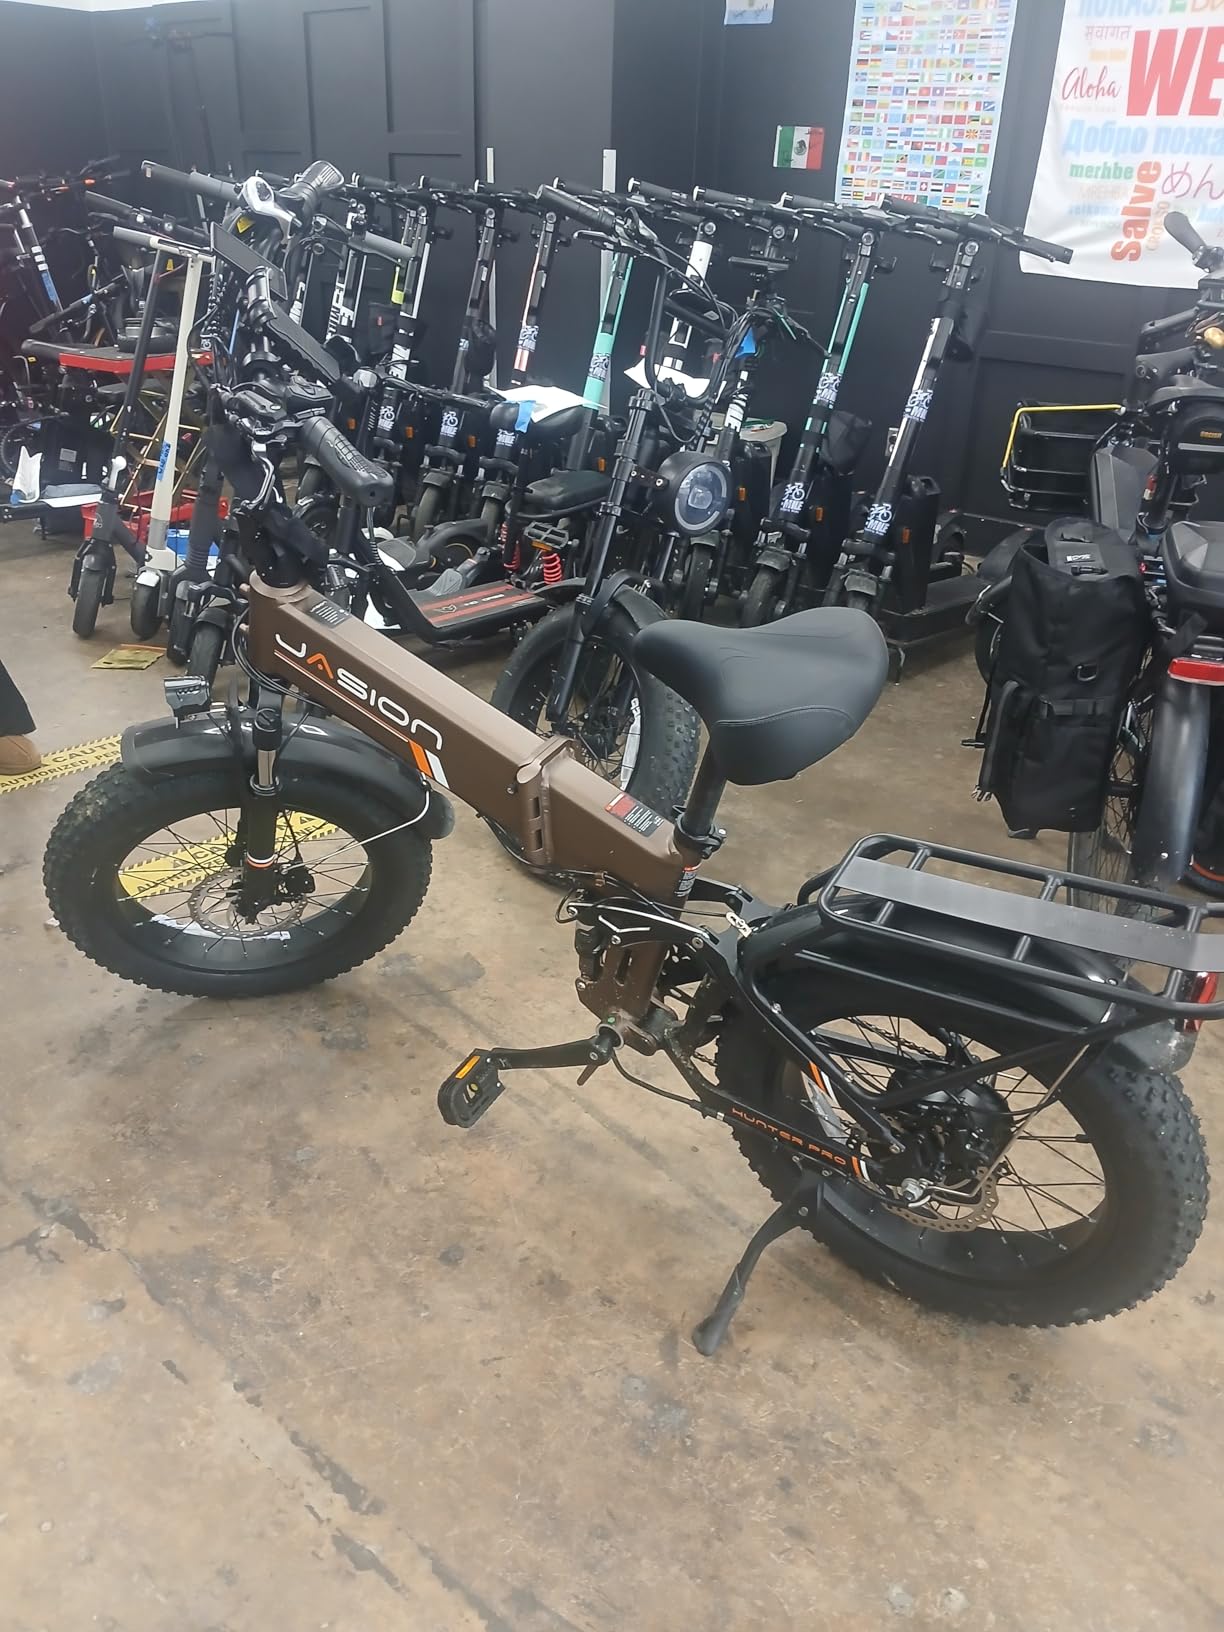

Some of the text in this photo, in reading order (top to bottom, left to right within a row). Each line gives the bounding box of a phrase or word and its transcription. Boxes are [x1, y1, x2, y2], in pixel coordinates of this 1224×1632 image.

[1061, 65, 1121, 100] Aloha
[1063, 119, 1148, 157] Добро
[1110, 160, 1162, 262] salve
[275, 633, 443, 751] JASION
[731, 1107, 847, 1166] HUNTER PRO
